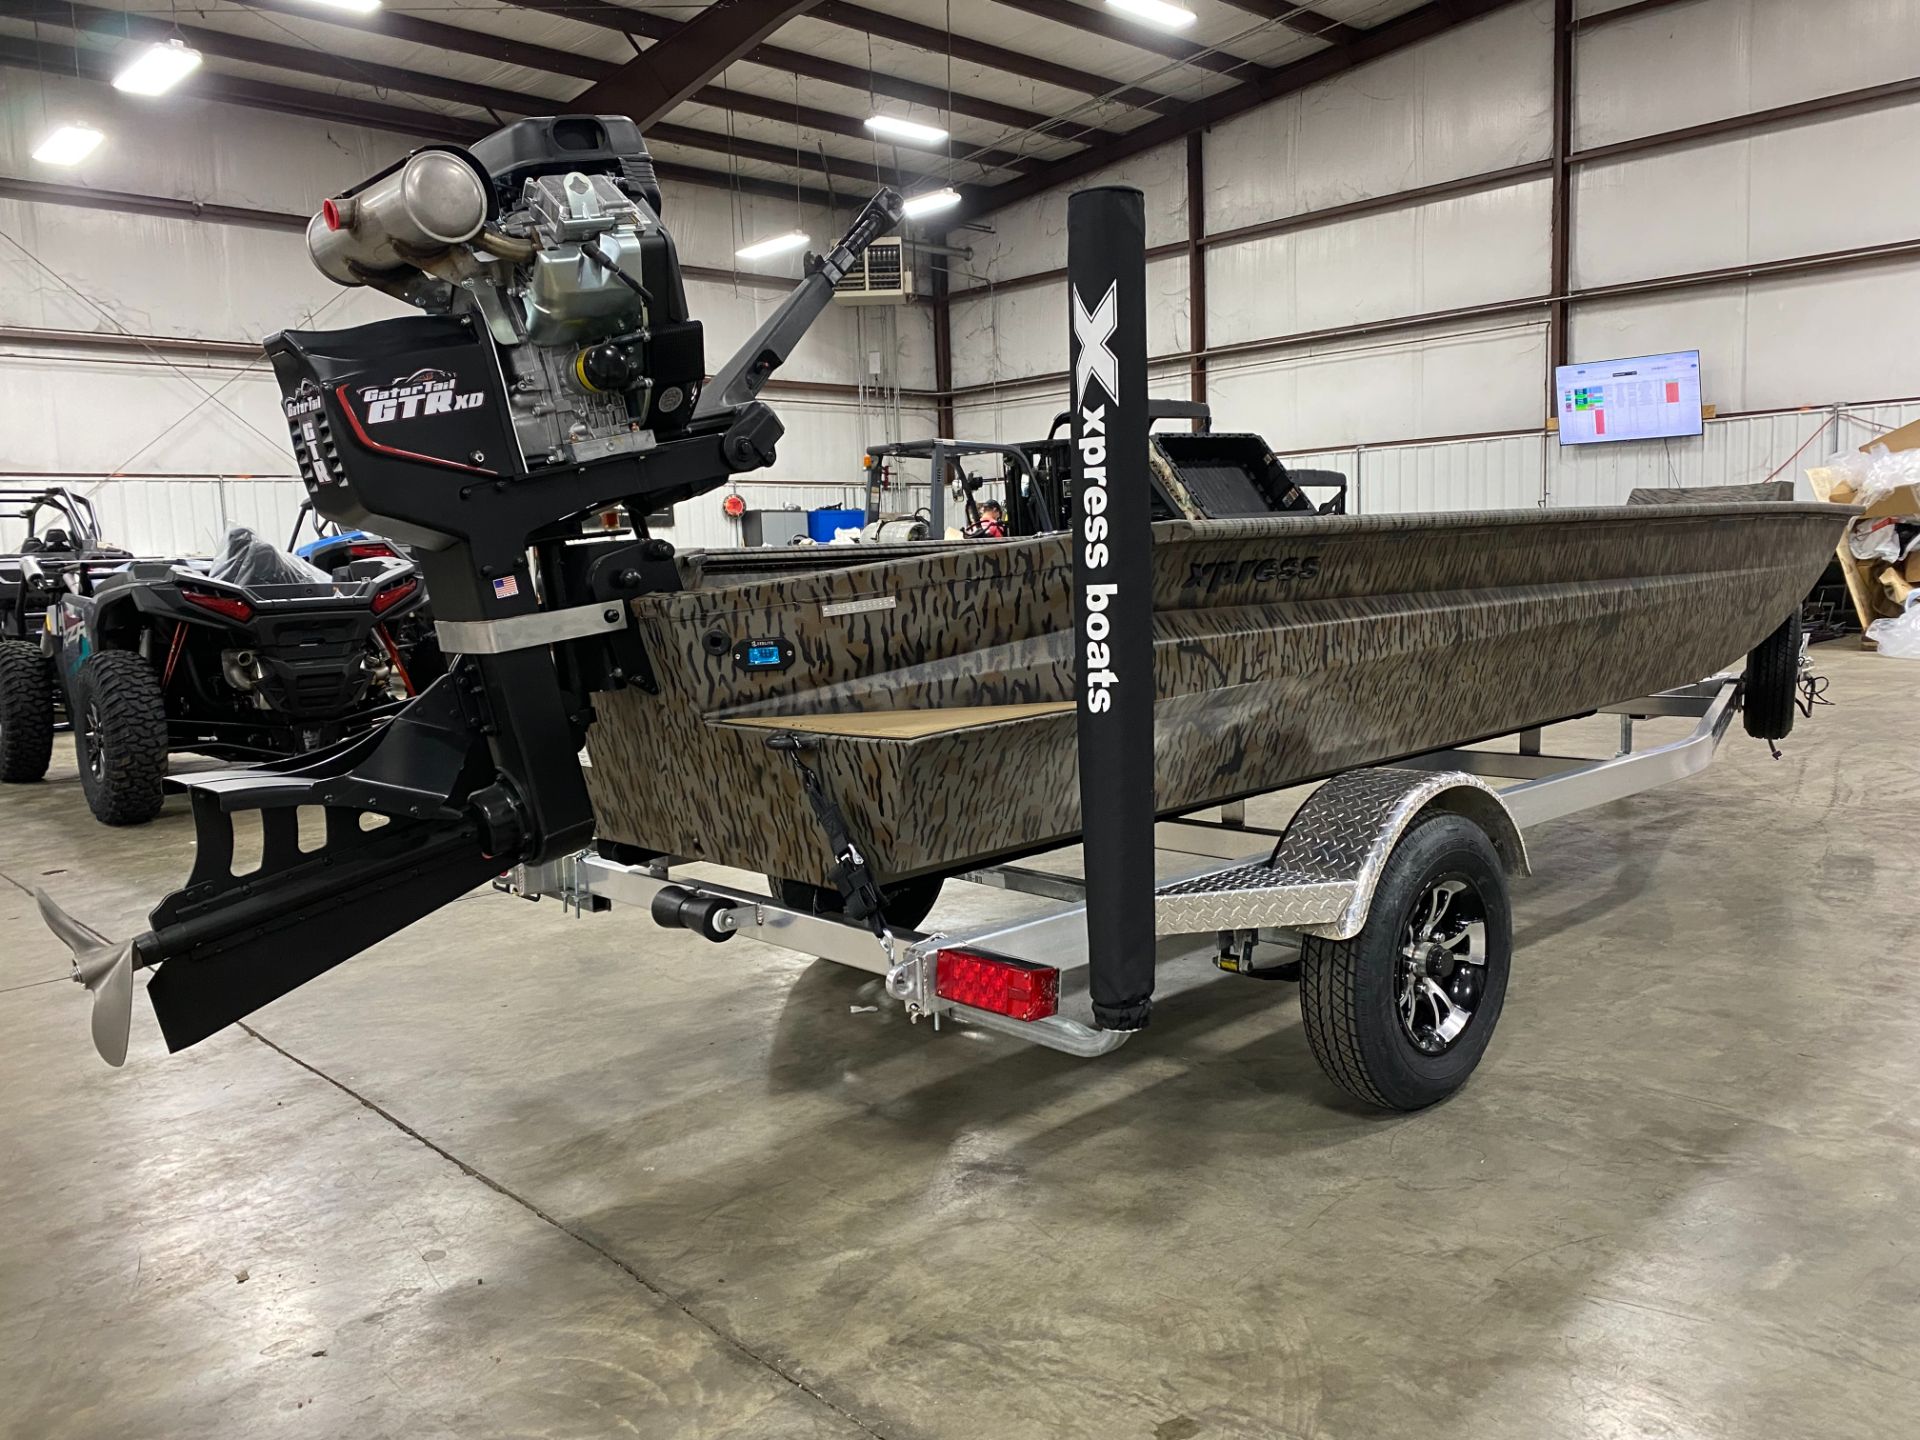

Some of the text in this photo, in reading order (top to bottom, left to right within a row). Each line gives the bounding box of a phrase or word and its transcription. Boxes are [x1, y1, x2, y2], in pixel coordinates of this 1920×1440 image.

[1073, 278, 1119, 414] X
[302, 421, 332, 483] GTR
[367, 390, 454, 424] GTR
[1078, 404, 1119, 713] xpress boats
